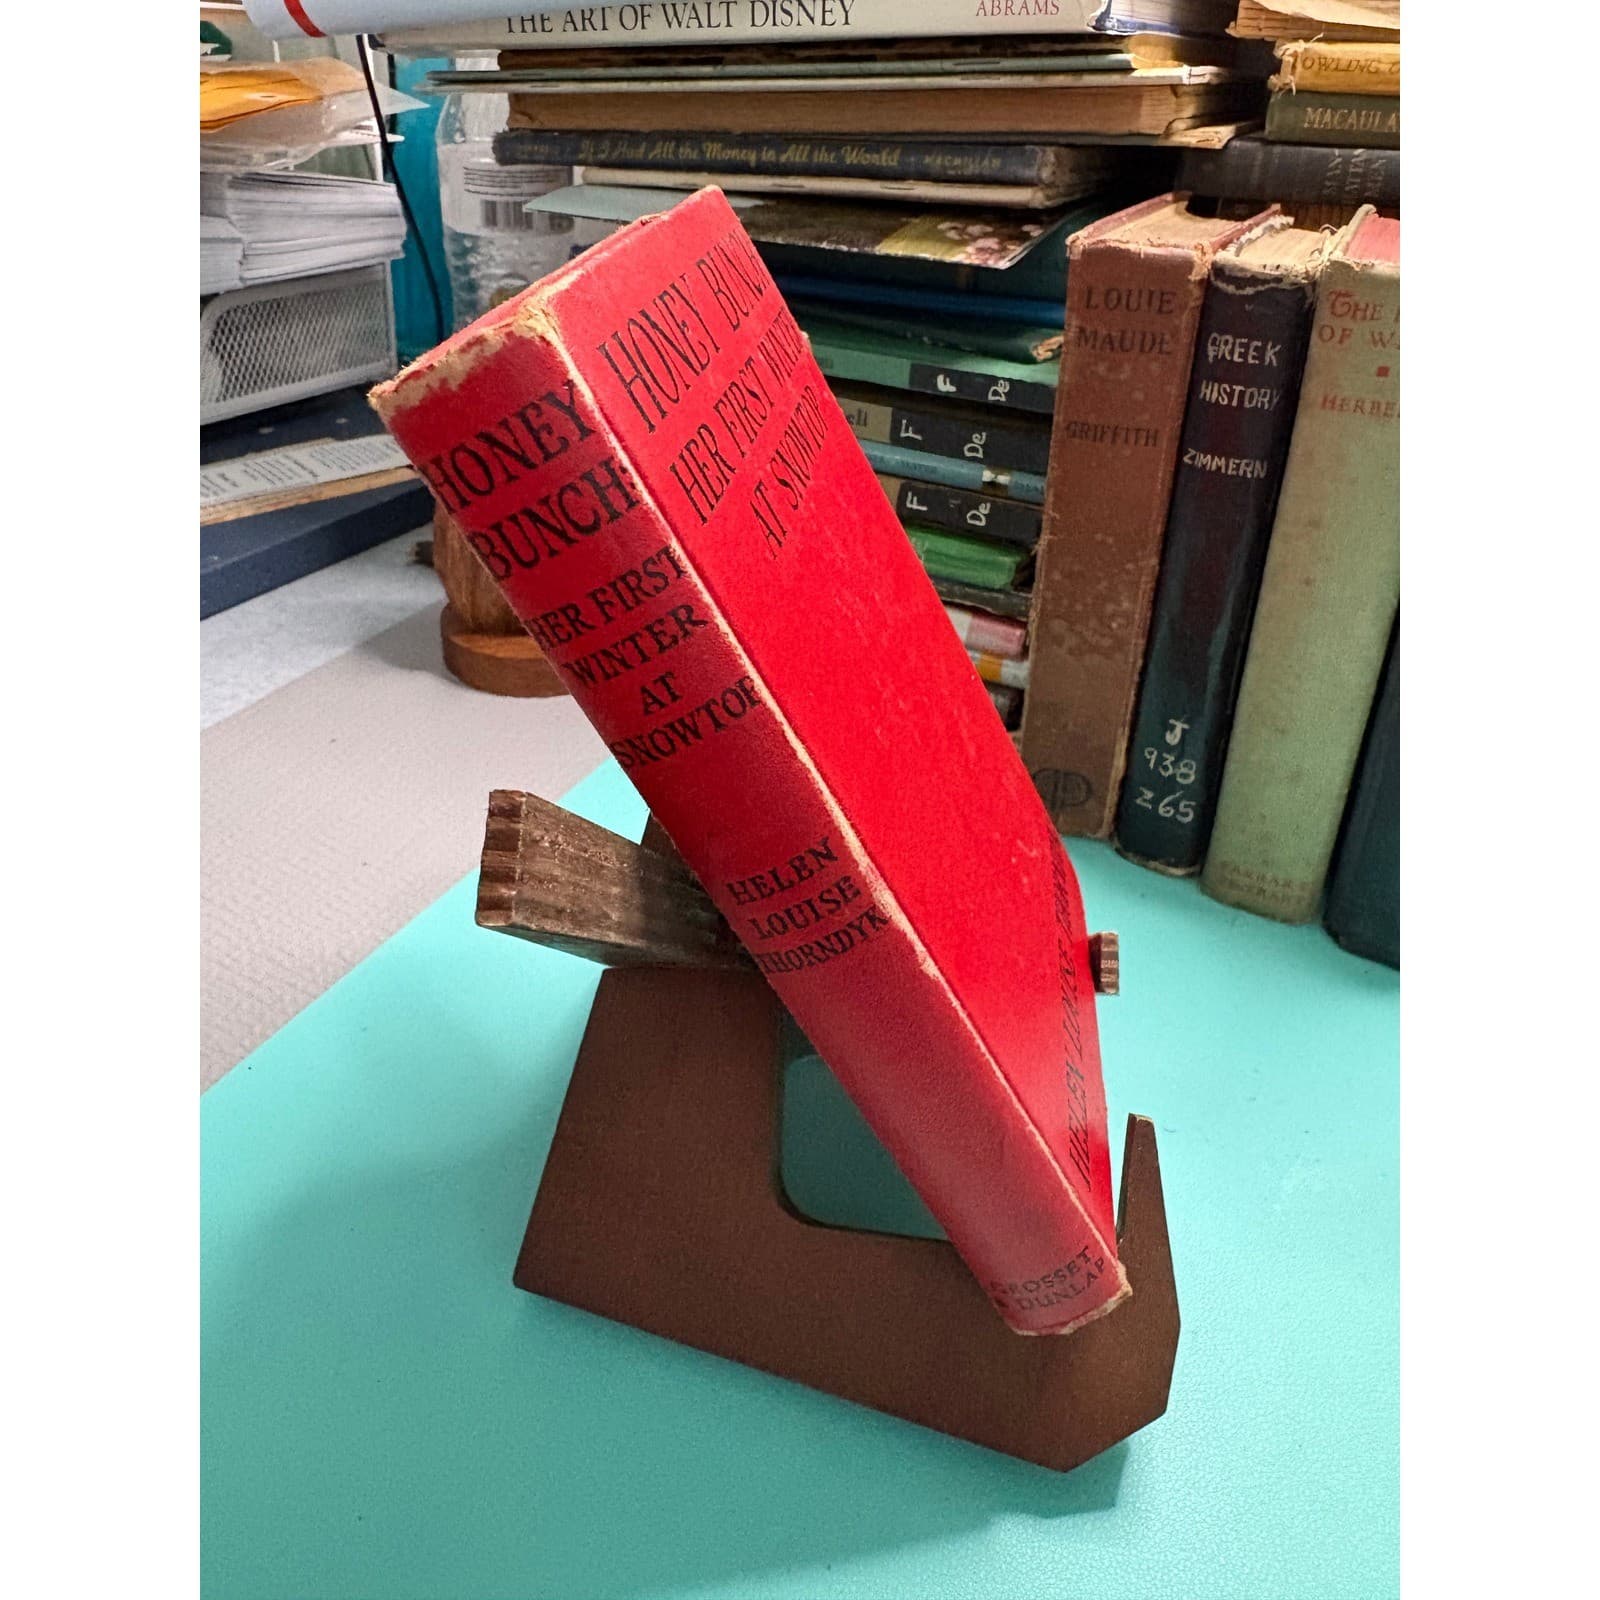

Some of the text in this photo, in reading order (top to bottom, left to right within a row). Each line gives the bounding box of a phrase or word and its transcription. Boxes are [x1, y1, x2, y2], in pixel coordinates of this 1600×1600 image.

[562, 7, 612, 32] ART
[618, 3, 653, 31] OF
[662, 0, 738, 30] WALT
[749, 0, 853, 28] DISNEY
[976, 0, 1060, 17] ABRAMS
[1303, 106, 1400, 133] MACAULA
[648, 140, 677, 161] All
[678, 141, 698, 160] the
[702, 141, 757, 167] Money
[760, 147, 777, 163] in
[779, 143, 809, 163] All
[812, 146, 837, 164] the
[841, 146, 901, 167] World
[1084, 285, 1177, 315] LOUIE
[1074, 325, 1173, 356] MAUDE
[1207, 331, 1282, 367] GREEK
[1318, 323, 1354, 346] OF
[596, 273, 721, 434] HONEY
[936, 373, 1011, 402] F De
[1199, 379, 1281, 411] HISTORY
[1320, 393, 1400, 420] HERBE
[427, 378, 596, 514] HONEY
[669, 423, 737, 526] HER
[713, 355, 776, 459] FIRST
[900, 418, 987, 459] F De
[1065, 420, 1160, 447] GRIFFITH
[750, 384, 829, 561] AT SNOWTOP
[1183, 447, 1268, 479] ZIMMERN
[466, 454, 641, 582] BUNCH
[905, 491, 992, 527] F De
[522, 544, 688, 652] HER FIRST
[562, 603, 709, 688] WINTER
[639, 670, 684, 716] AT
[608, 674, 762, 770] SNOWTOP
[1165, 719, 1191, 746] J
[1143, 746, 1197, 785] 938
[725, 835, 839, 907] HELEN
[748, 874, 862, 941] LOUISE
